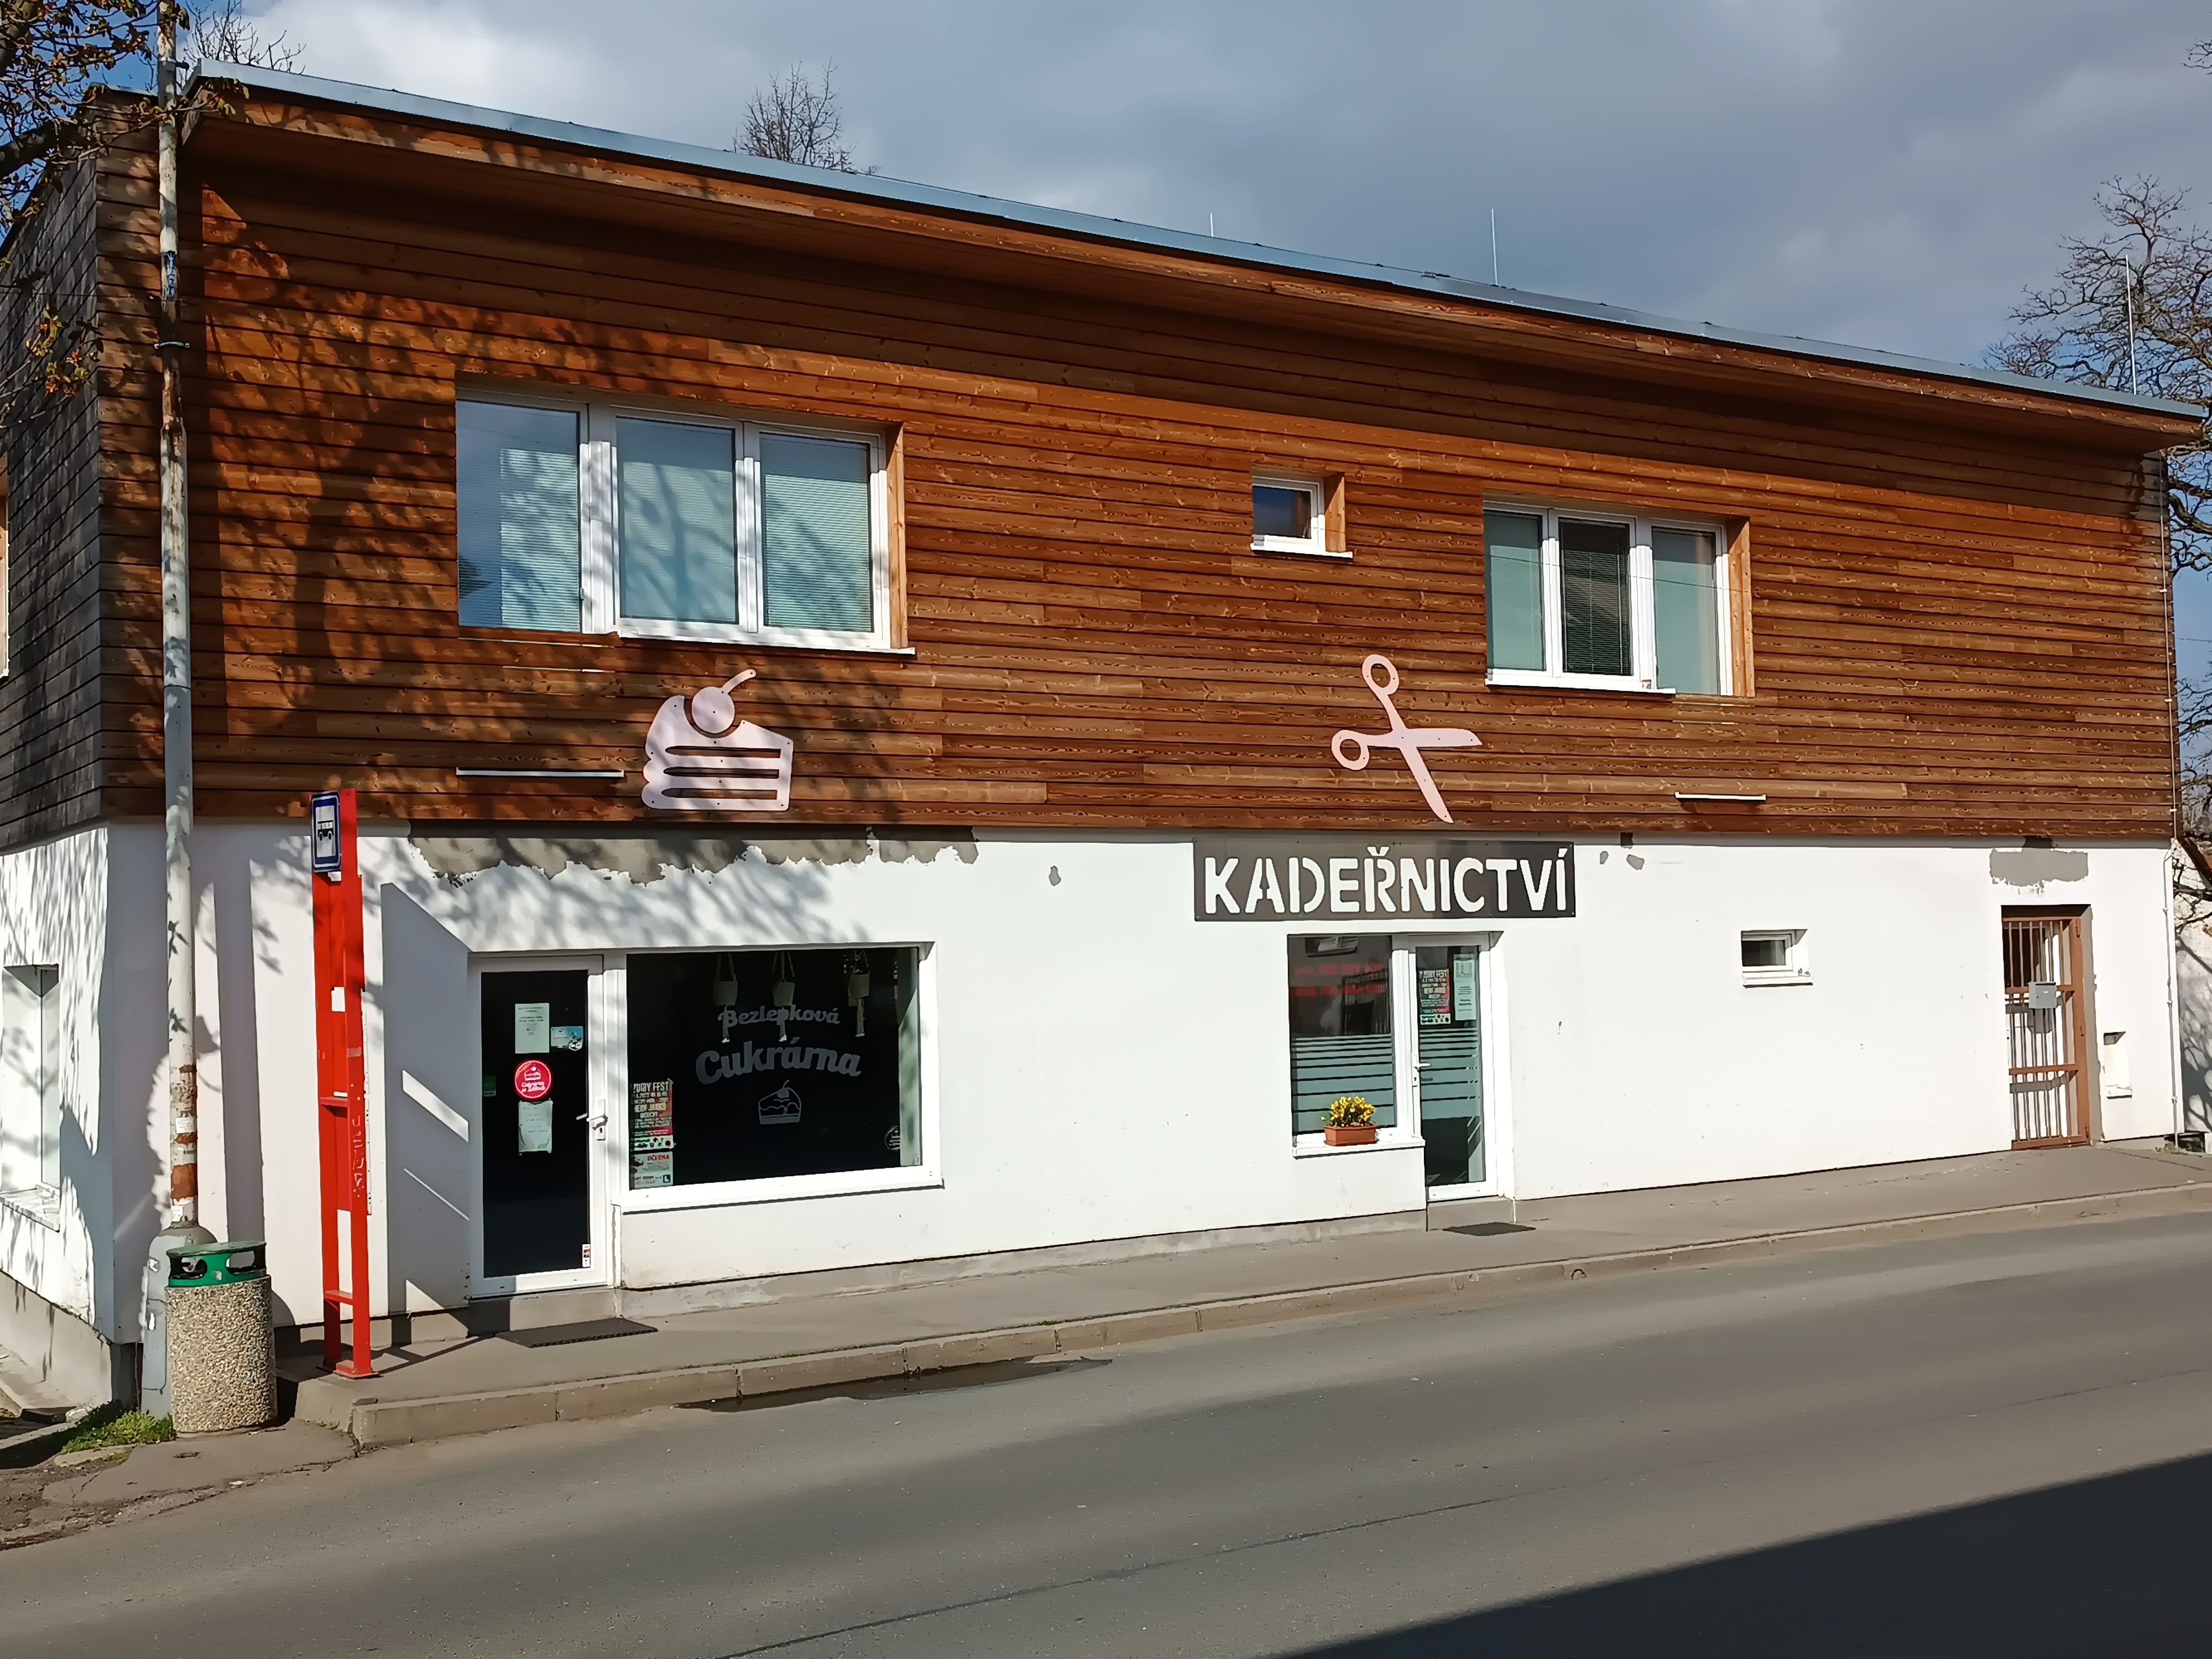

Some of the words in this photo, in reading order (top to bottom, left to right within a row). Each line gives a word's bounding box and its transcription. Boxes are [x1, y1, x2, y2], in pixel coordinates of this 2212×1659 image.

[1205, 846, 1567, 914] KADEŘNICTVÍ
[717, 1004, 841, 1027] Bezlepková
[695, 1036, 862, 1084] Cukrárna
[653, 1081, 669, 1092] FEST
